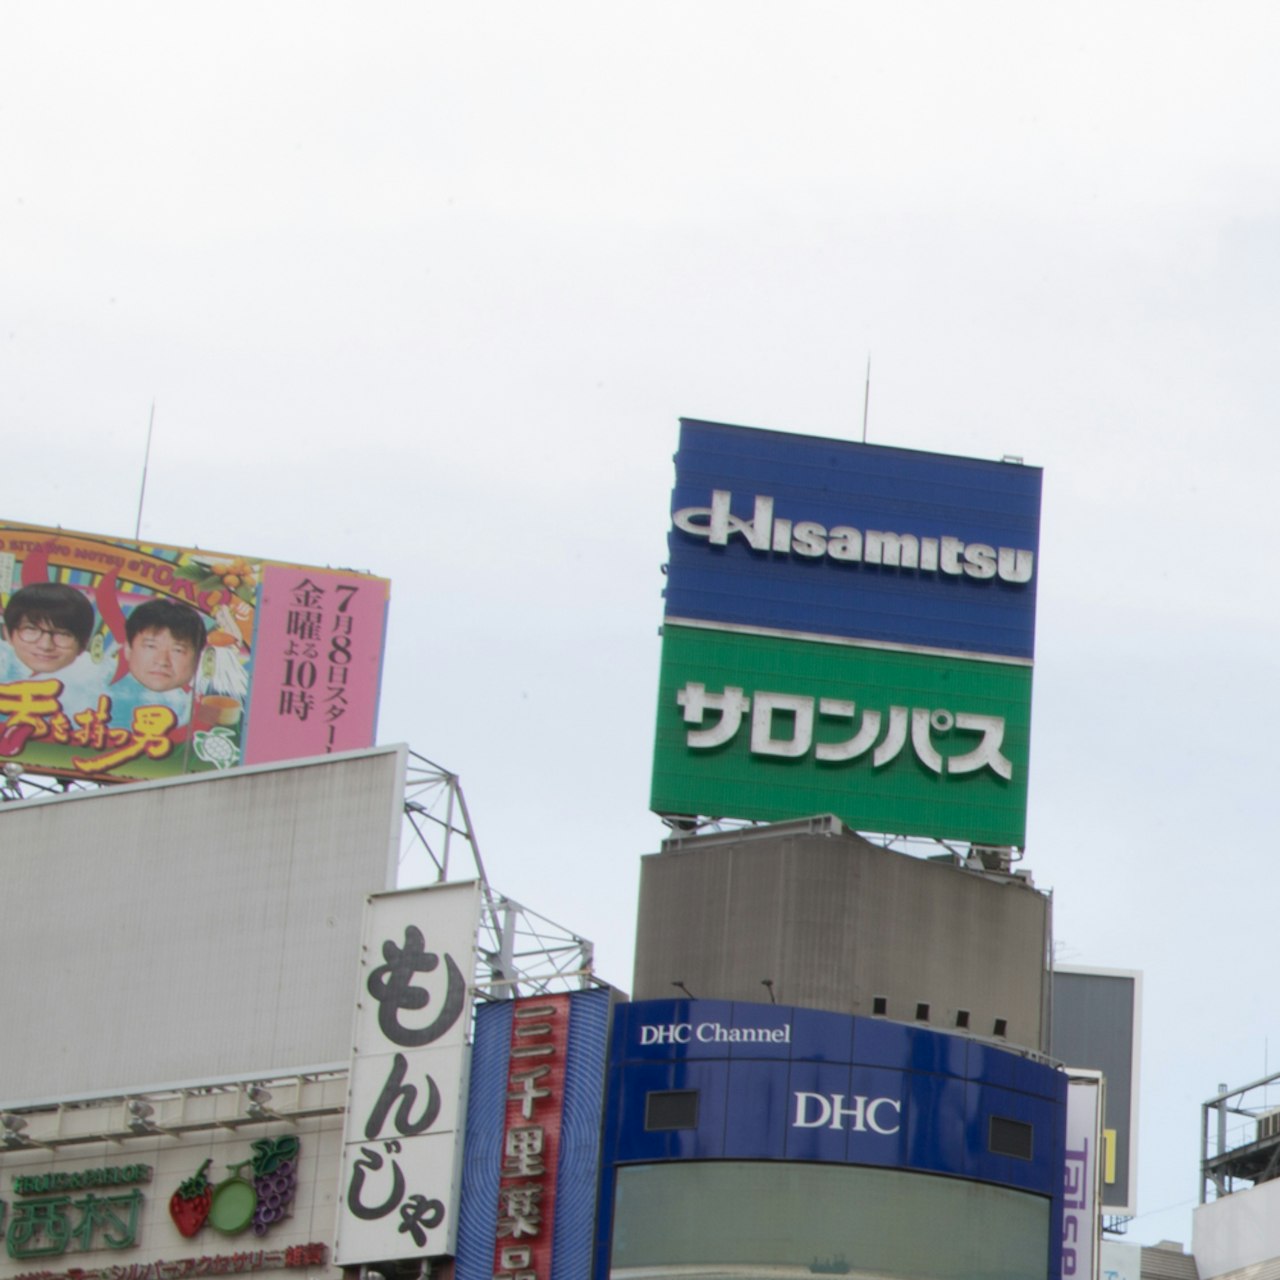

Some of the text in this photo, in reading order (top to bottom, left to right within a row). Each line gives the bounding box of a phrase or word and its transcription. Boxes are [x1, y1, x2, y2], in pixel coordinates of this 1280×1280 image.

[672, 489, 1034, 584] Hisamitsu
[278, 578, 326, 722] 金曜よる10時
[322, 584, 360, 754] 7月8日スター
[676, 681, 1014, 782] サロンパス
[640, 1022, 792, 1046] DHC Channel
[346, 924, 467, 1247] もんじゃ
[792, 1090, 902, 1135] DHC
[6, 1187, 144, 1260] 西村
